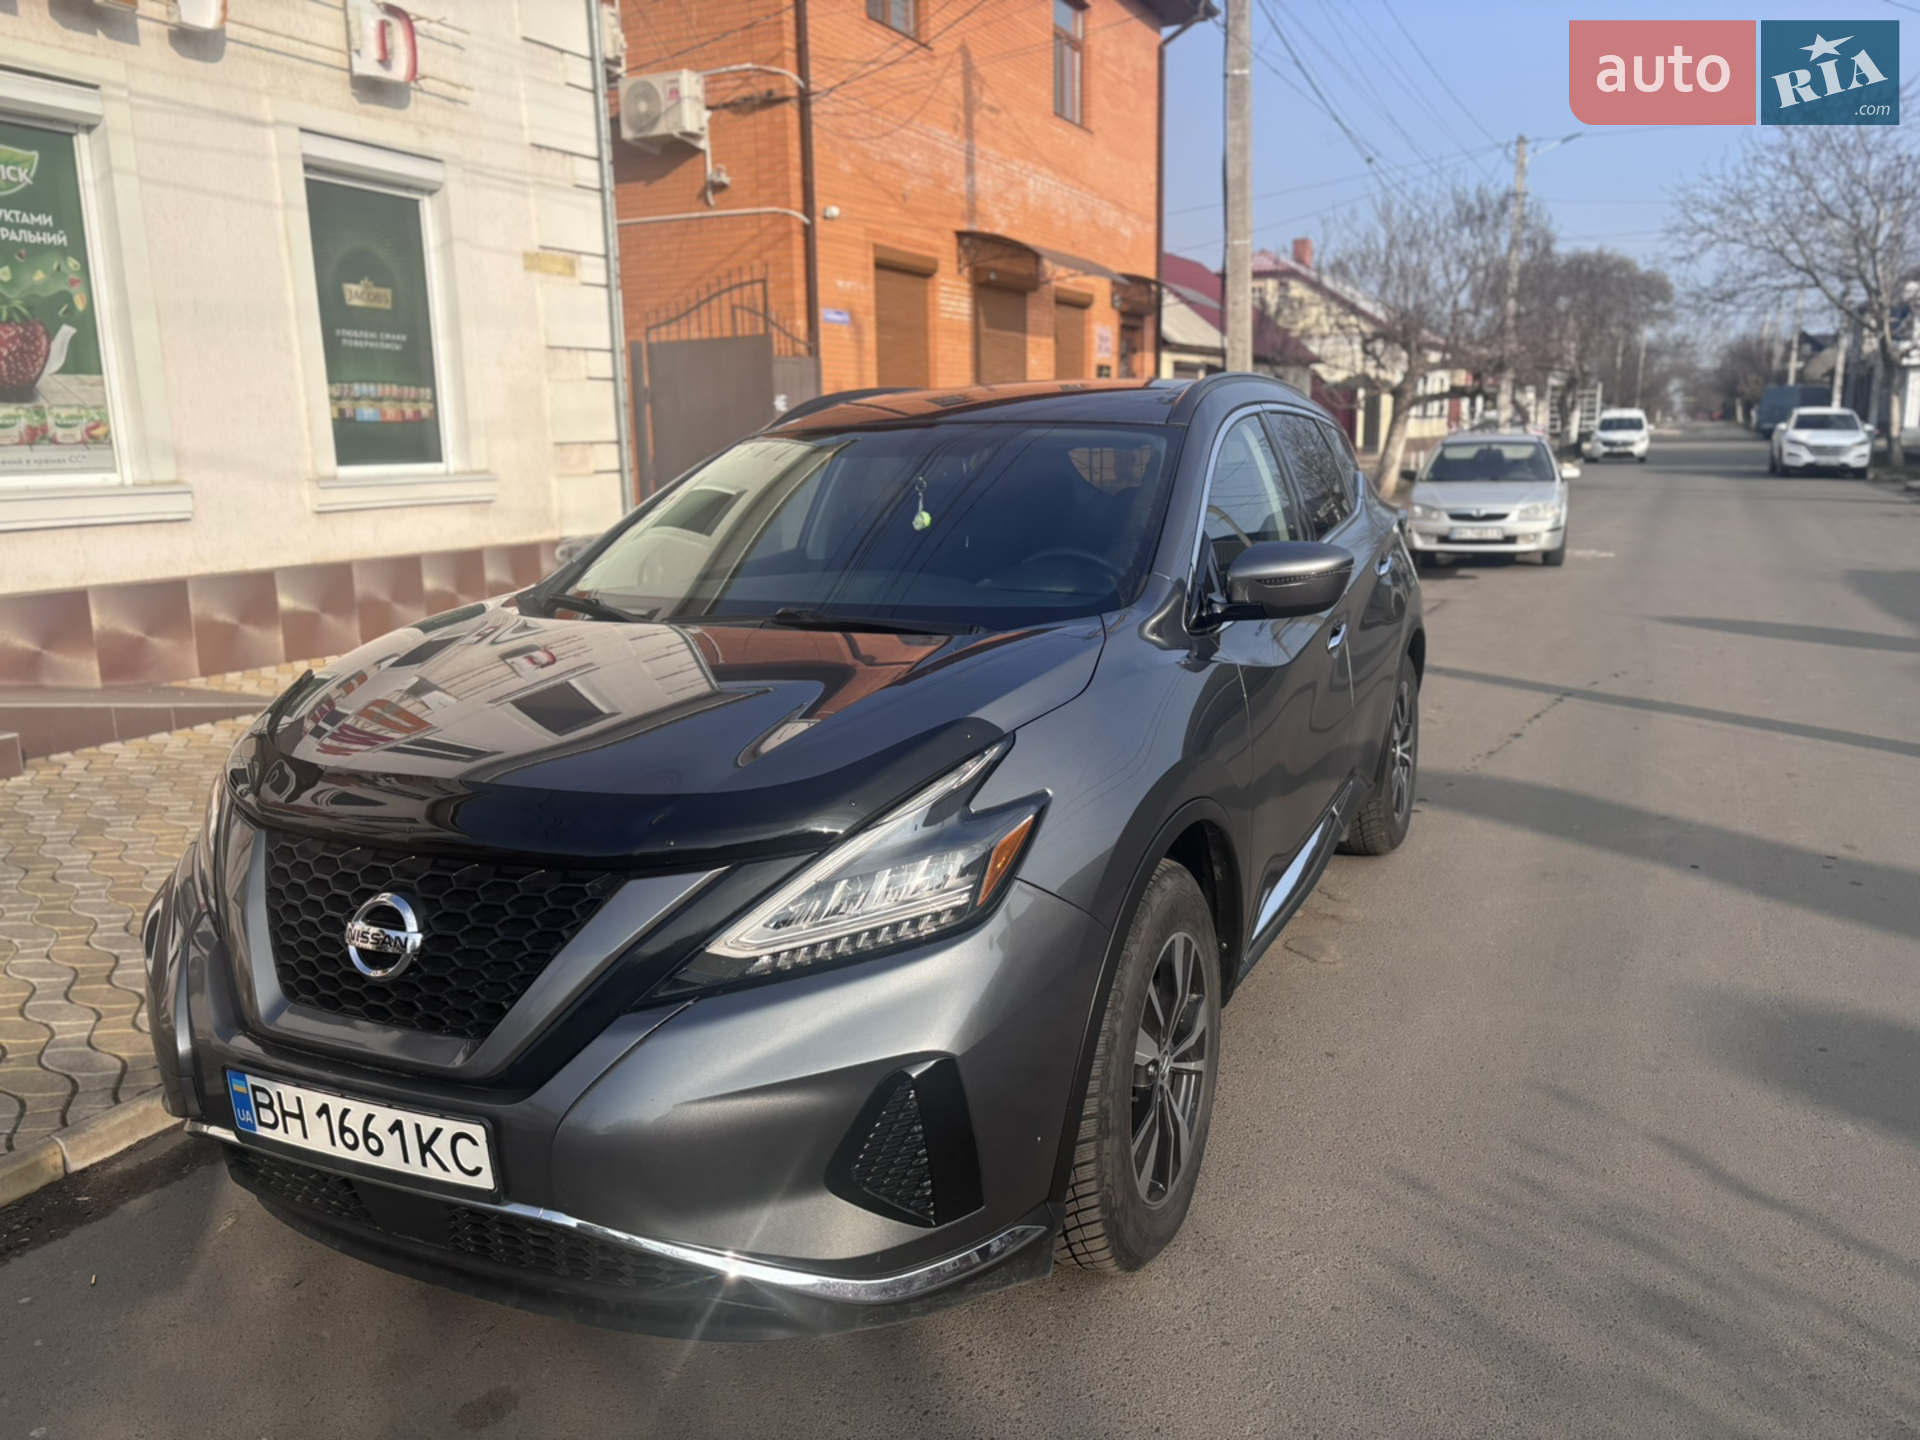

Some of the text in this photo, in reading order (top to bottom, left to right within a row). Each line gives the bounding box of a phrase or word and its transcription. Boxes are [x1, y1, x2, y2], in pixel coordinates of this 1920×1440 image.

[0, 227, 68, 247] РАЛЬНИЙ
[346, 288, 389, 304] JACOBS
[346, 927, 409, 950] NISSAN
[237, 1107, 254, 1125] UA
